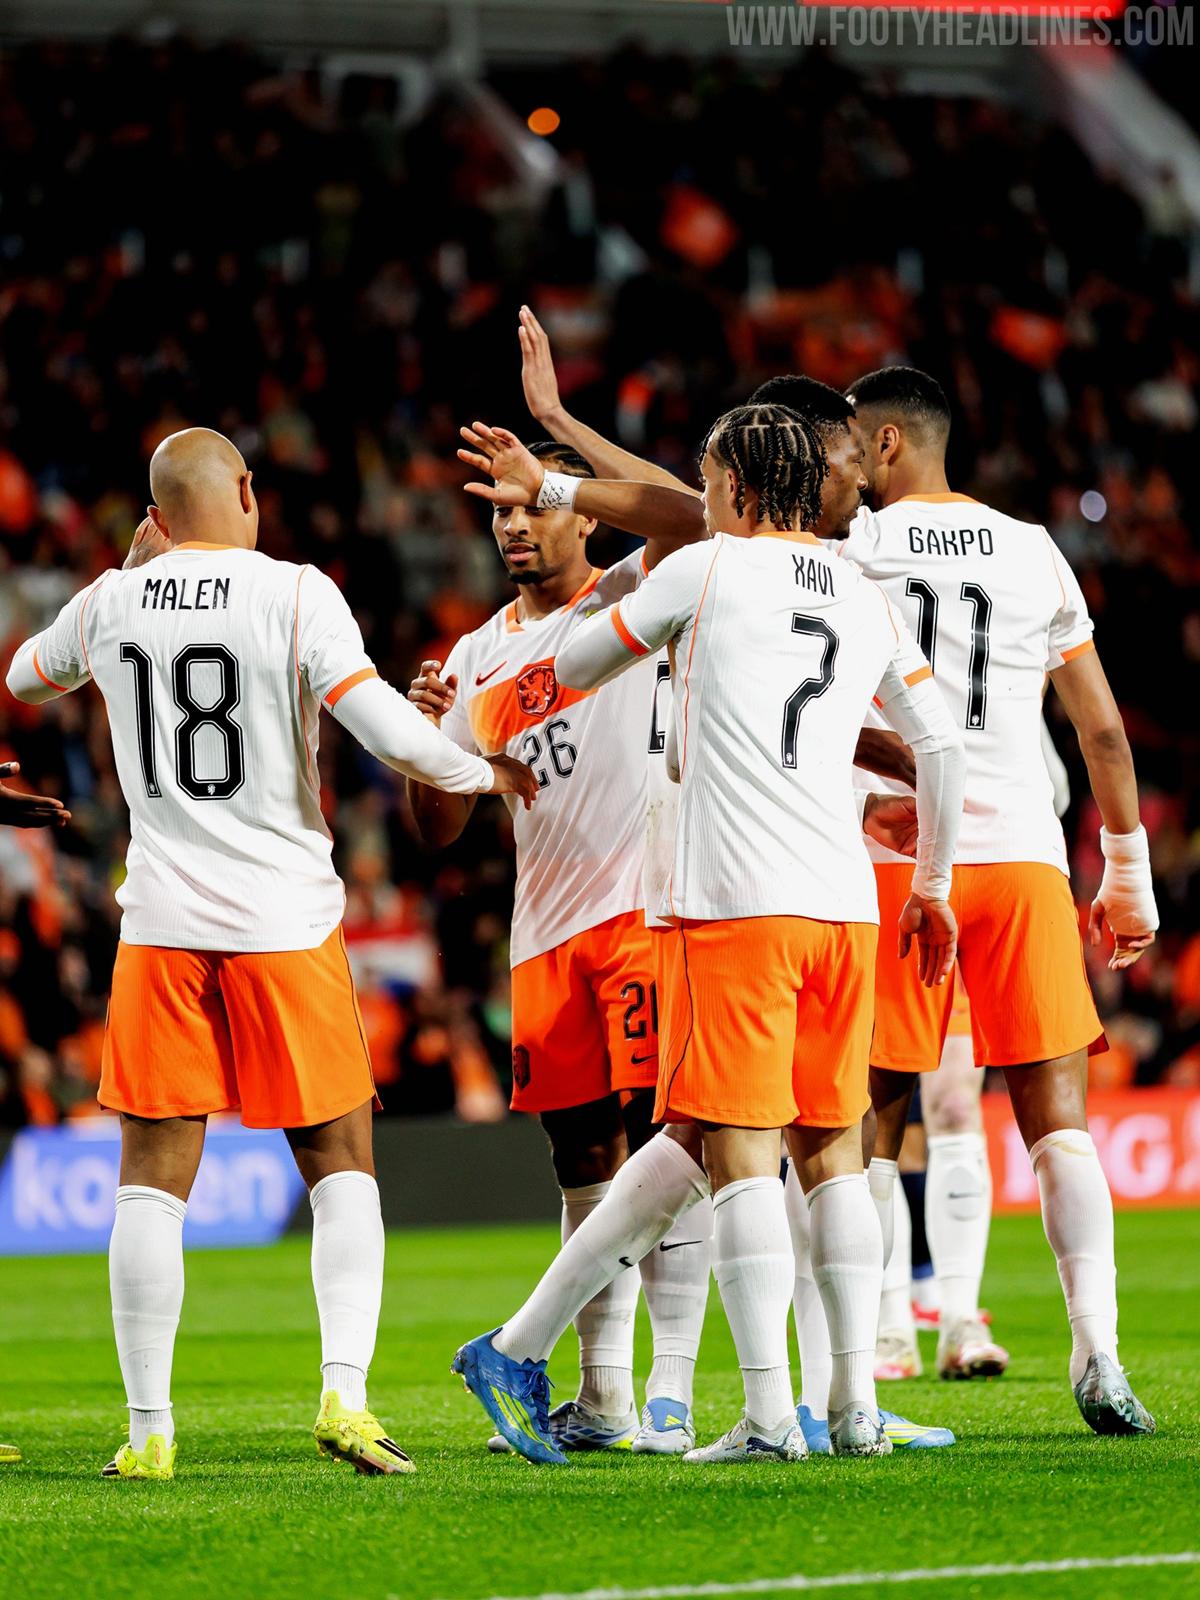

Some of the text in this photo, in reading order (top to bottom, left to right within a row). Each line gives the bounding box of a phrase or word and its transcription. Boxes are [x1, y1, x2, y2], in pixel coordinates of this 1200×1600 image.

[792, 554, 835, 598] XAVI
[908, 526, 994, 556] GAKPO
[142, 577, 231, 610] MALEN
[905, 577, 993, 730] 11
[120, 642, 246, 800] 18
[782, 612, 840, 769] 7
[523, 718, 578, 789] 26
